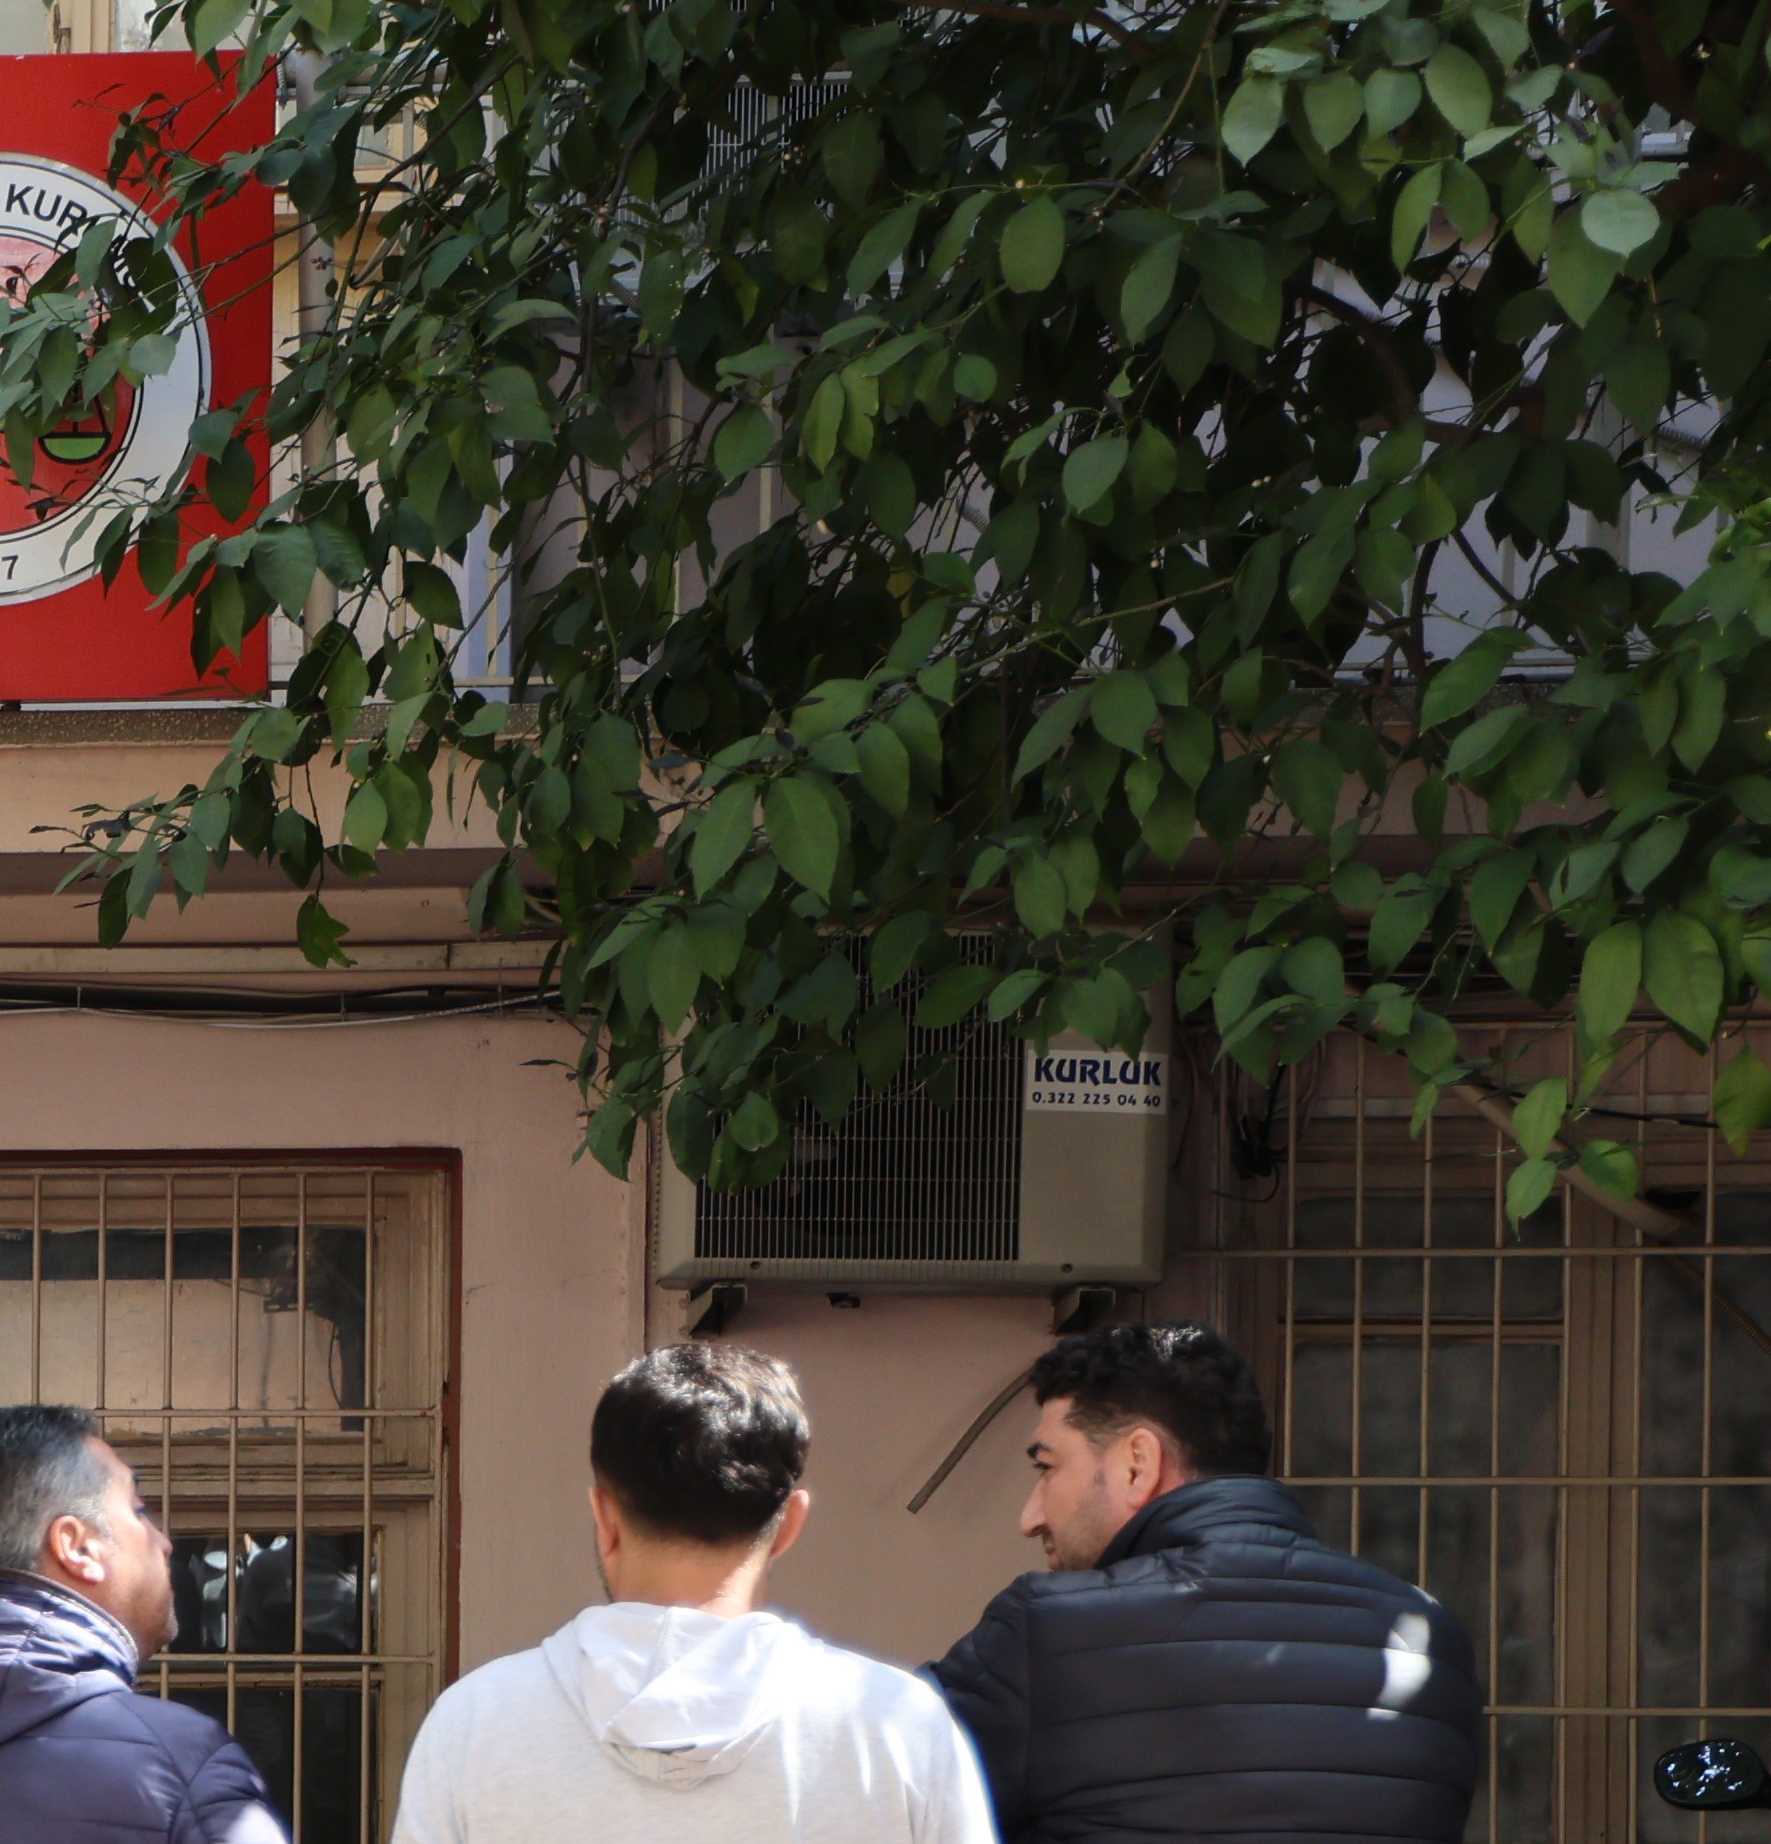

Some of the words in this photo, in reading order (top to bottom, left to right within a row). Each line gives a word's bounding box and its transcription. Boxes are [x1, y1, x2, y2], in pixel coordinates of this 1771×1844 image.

[1031, 1091, 1075, 1105] 0.322
[1082, 1092, 1111, 1106] 225
[1117, 1094, 1137, 1107] 04
[1143, 1095, 1161, 1108] 40
